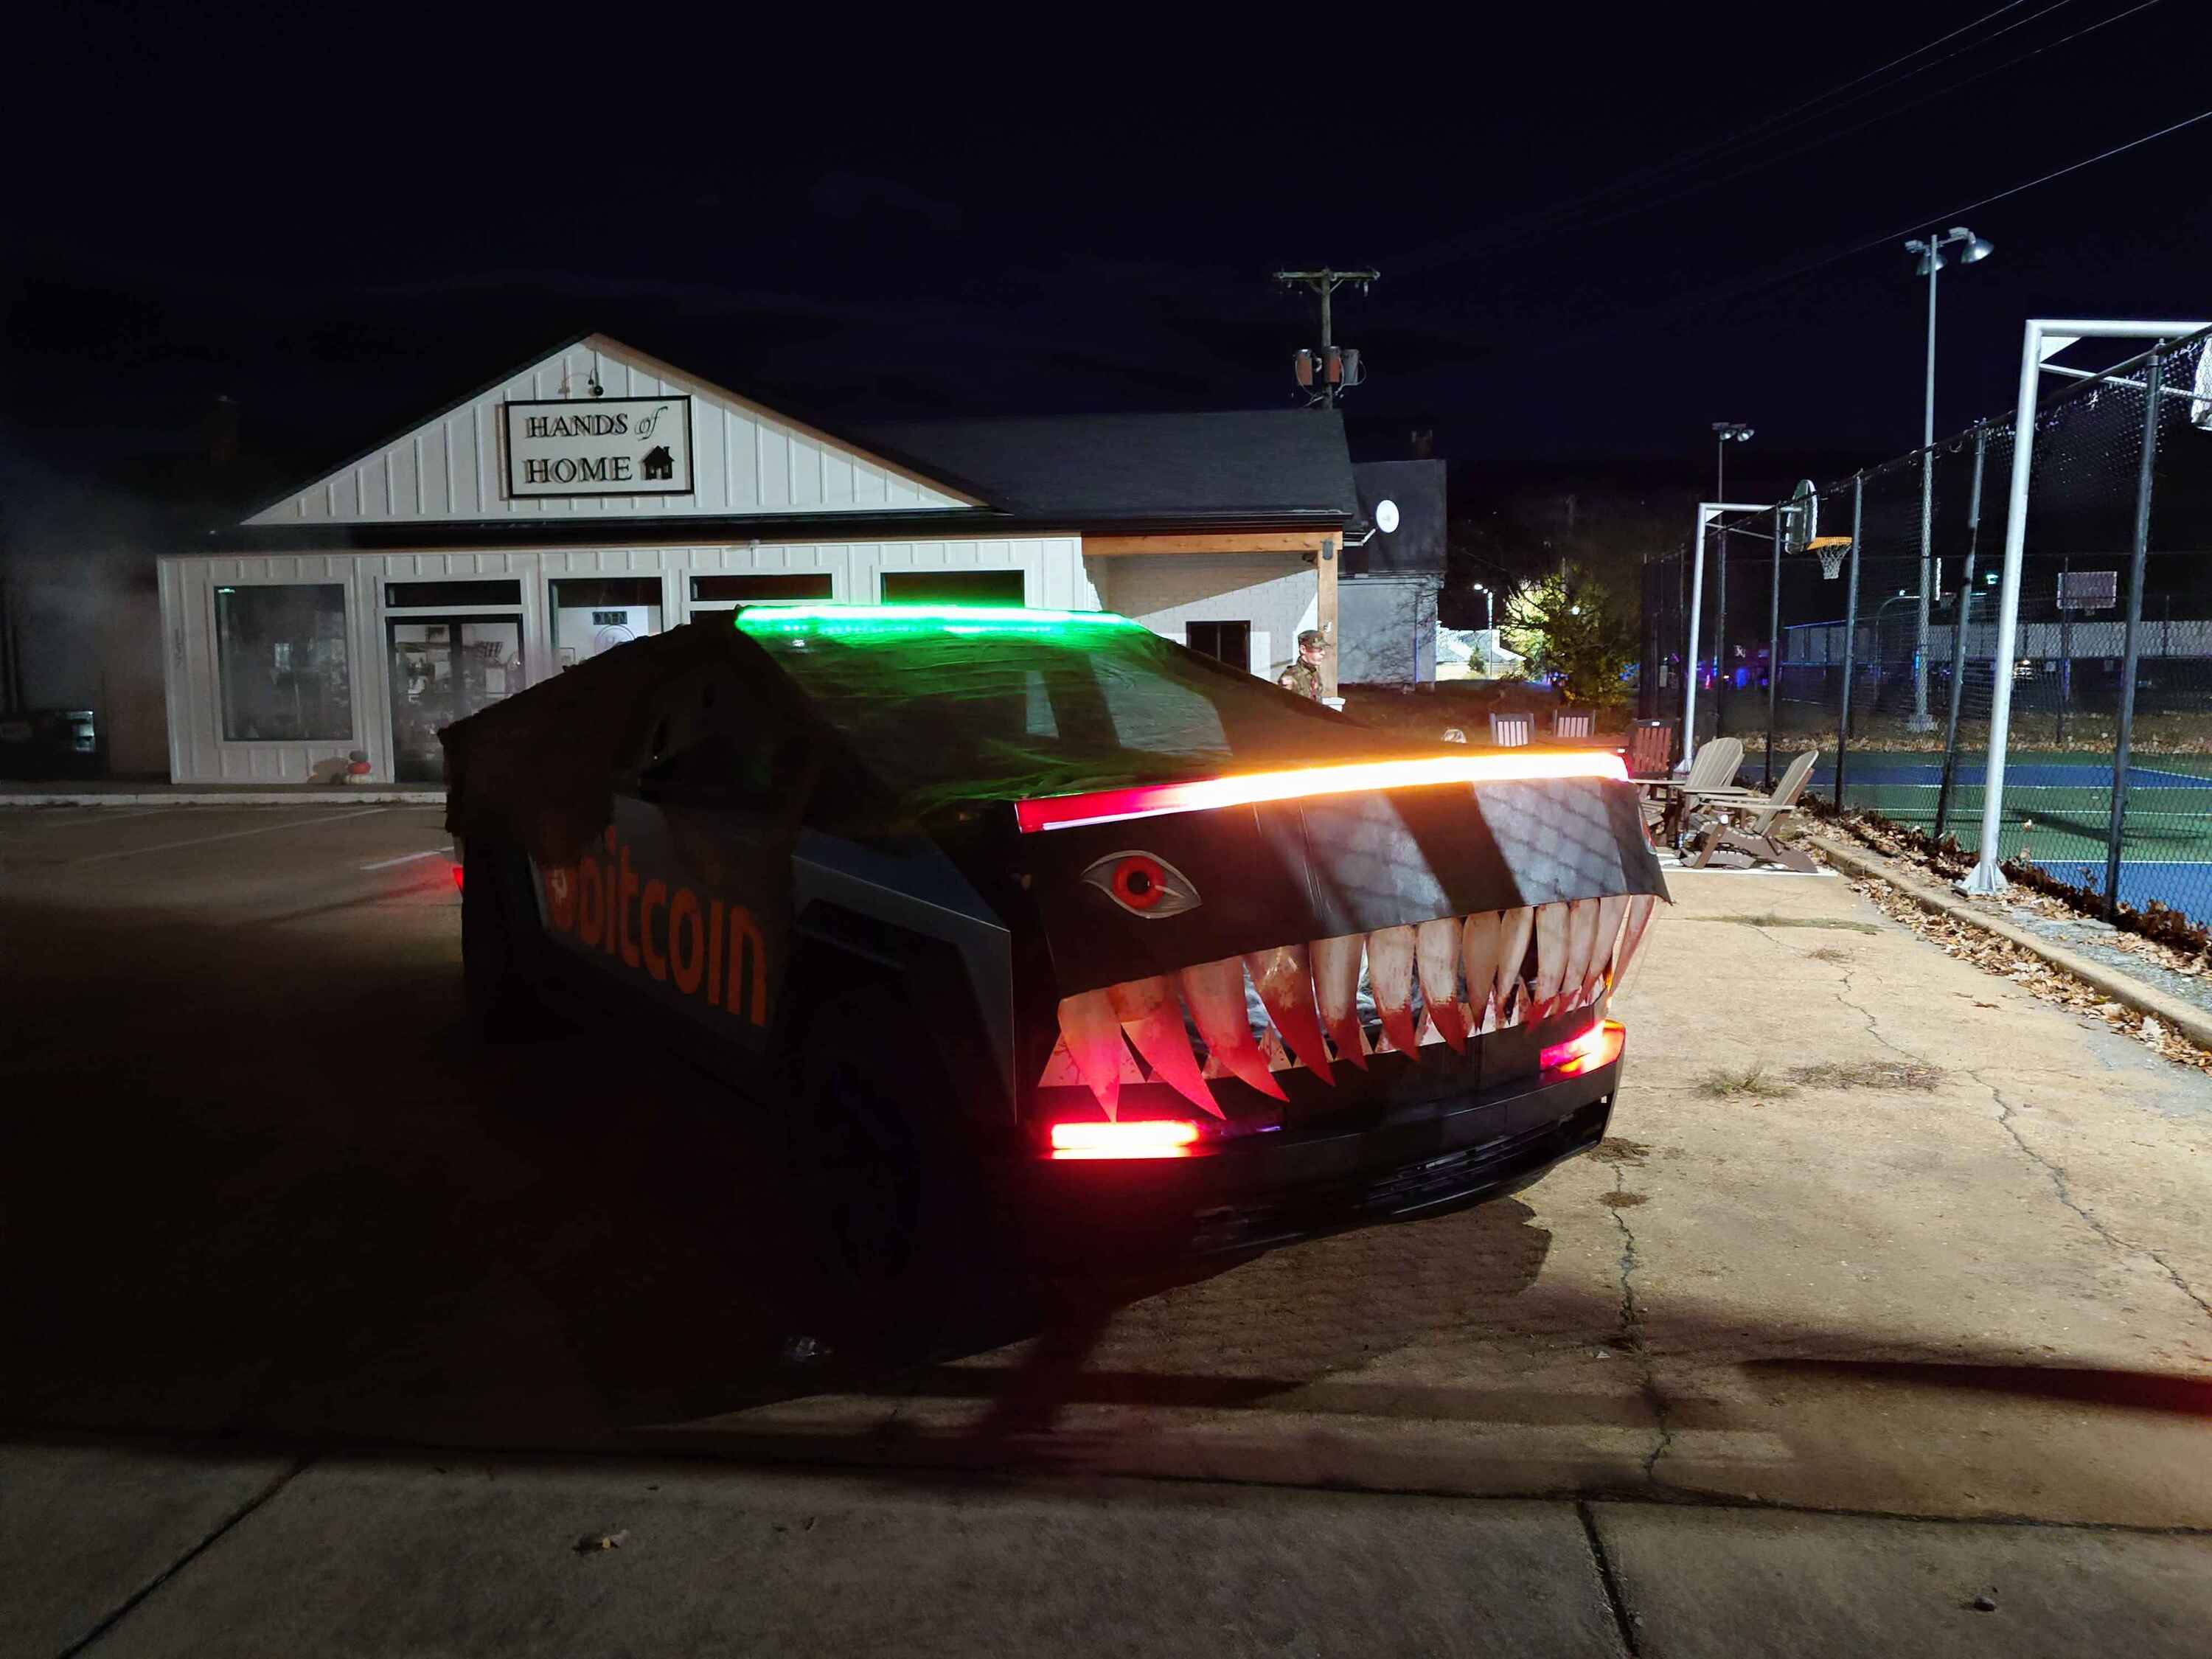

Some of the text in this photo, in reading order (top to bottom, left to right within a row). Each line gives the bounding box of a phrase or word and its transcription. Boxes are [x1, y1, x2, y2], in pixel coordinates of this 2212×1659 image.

[529, 406, 668, 441] HANDS of
[527, 456, 633, 484] HOME
